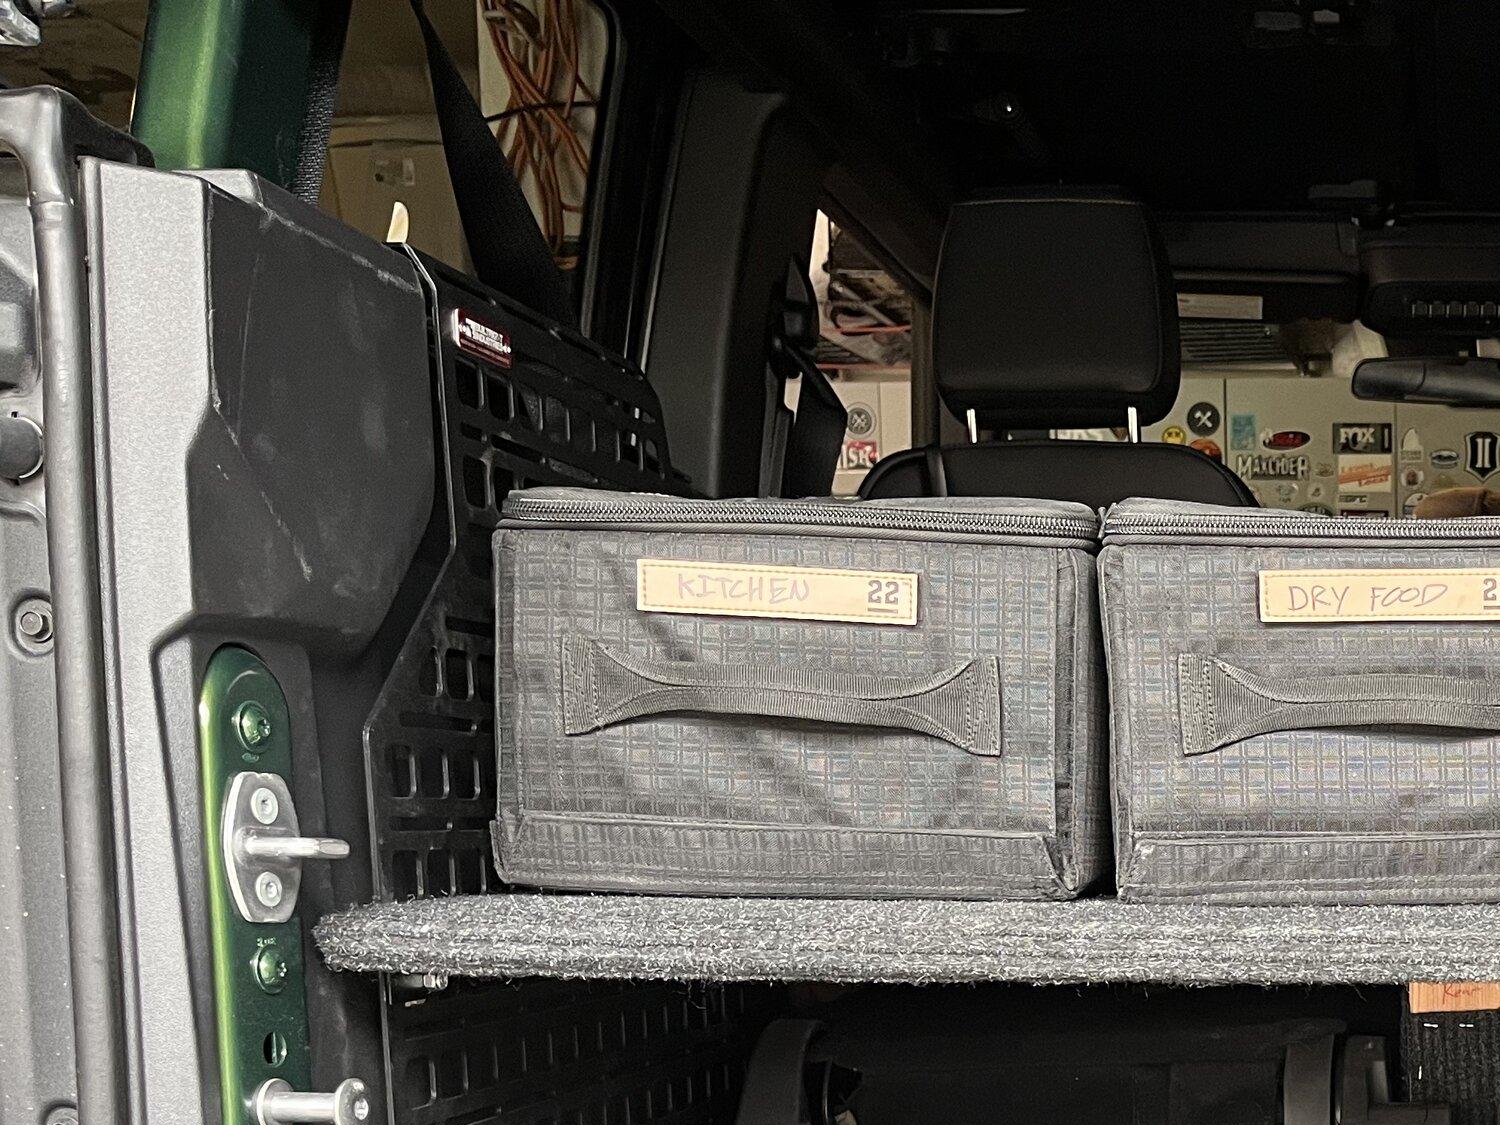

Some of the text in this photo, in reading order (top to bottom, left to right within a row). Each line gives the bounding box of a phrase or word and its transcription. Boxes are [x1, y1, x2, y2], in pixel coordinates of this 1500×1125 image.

[1339, 427, 1376, 451] FOX
[677, 573, 811, 605] KITCHEN
[867, 579, 900, 604] 22
[1288, 583, 1449, 614] DRY FOOD
